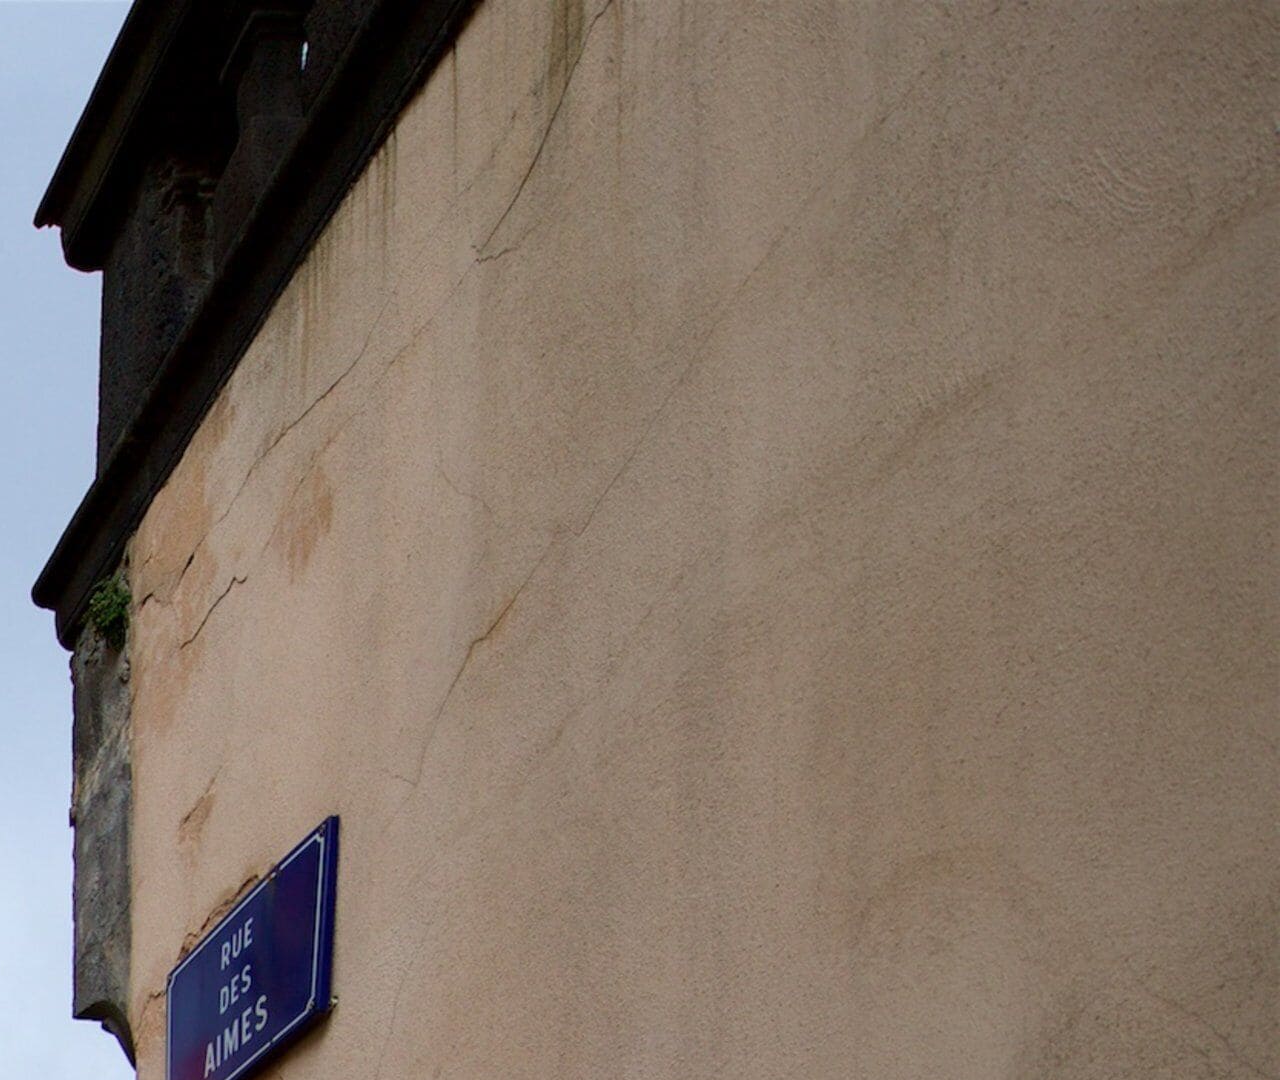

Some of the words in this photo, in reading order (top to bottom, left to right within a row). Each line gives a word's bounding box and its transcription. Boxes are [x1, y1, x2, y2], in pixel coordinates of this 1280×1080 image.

[220, 917, 253, 971] RUE
[219, 964, 252, 1014] DES
[204, 995, 268, 1079] AIMES
